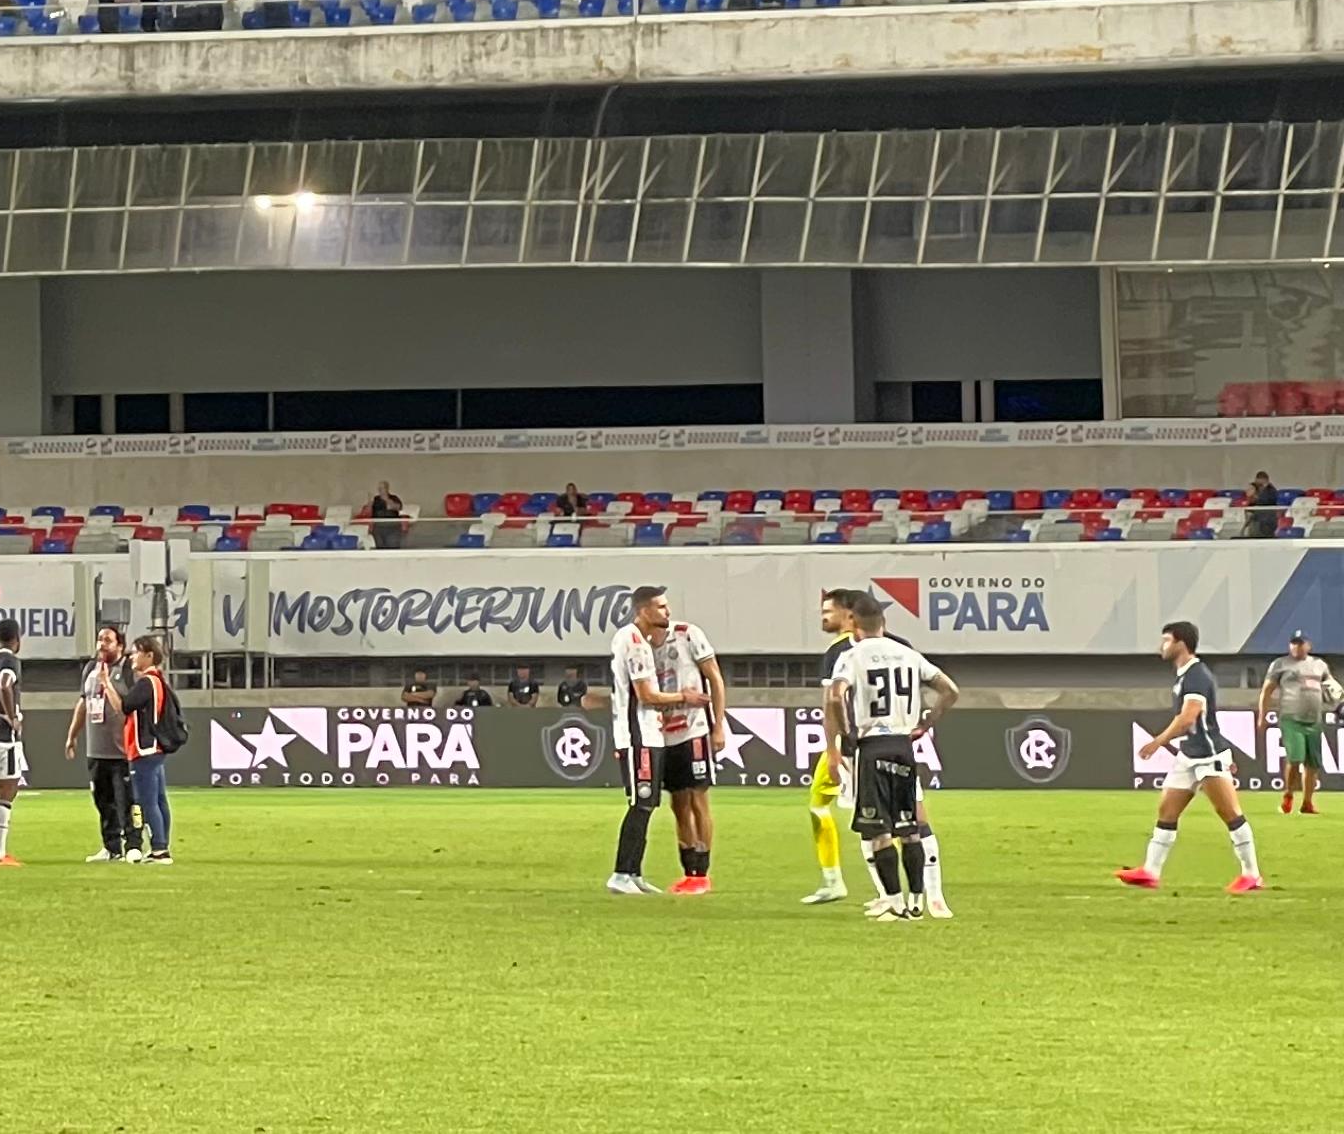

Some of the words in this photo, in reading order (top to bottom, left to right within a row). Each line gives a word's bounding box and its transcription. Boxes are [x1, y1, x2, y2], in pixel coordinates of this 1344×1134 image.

[929, 577, 1012, 588] GOVERNO
[1021, 577, 1044, 588] DO
[867, 667, 912, 717] 34
[337, 708, 436, 720] GOVERNO
[446, 708, 474, 720] DO
[212, 774, 261, 785] POR
[283, 773, 355, 785] TODO
[377, 773, 390, 785] O
